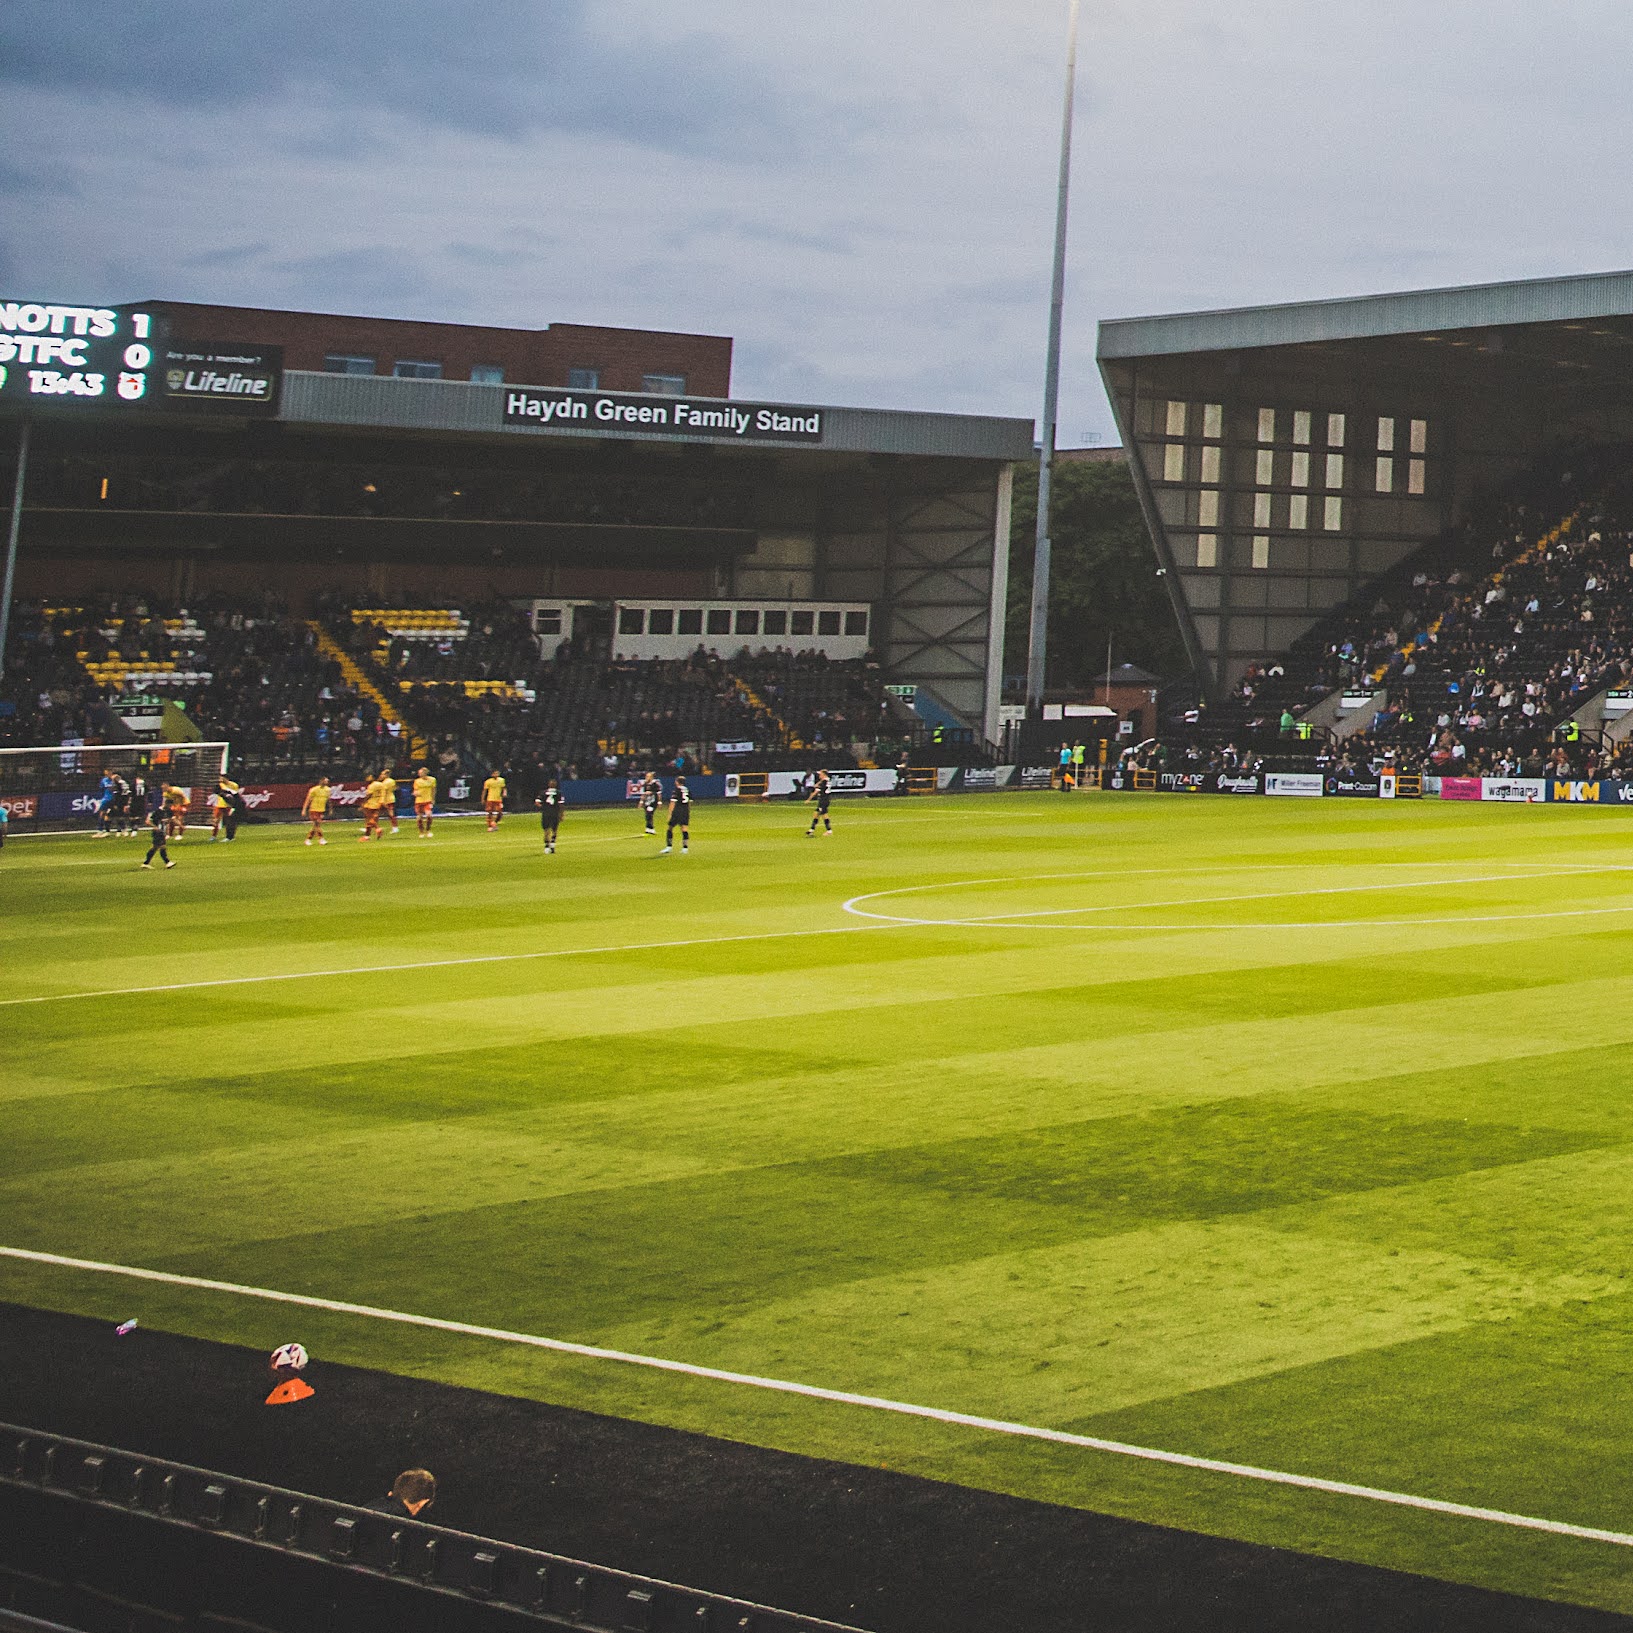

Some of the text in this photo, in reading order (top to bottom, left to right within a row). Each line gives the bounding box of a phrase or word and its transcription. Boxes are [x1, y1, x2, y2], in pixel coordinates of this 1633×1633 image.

[0, 302, 150, 338] NOTTS 1
[124, 343, 151, 369] 0
[28, 369, 105, 396] 13:43
[184, 371, 268, 395] Lifeline
[507, 394, 820, 434] Haydn Green Family Stand
[1489, 784, 1539, 799] wagamama
[1554, 781, 1600, 801] MKM
